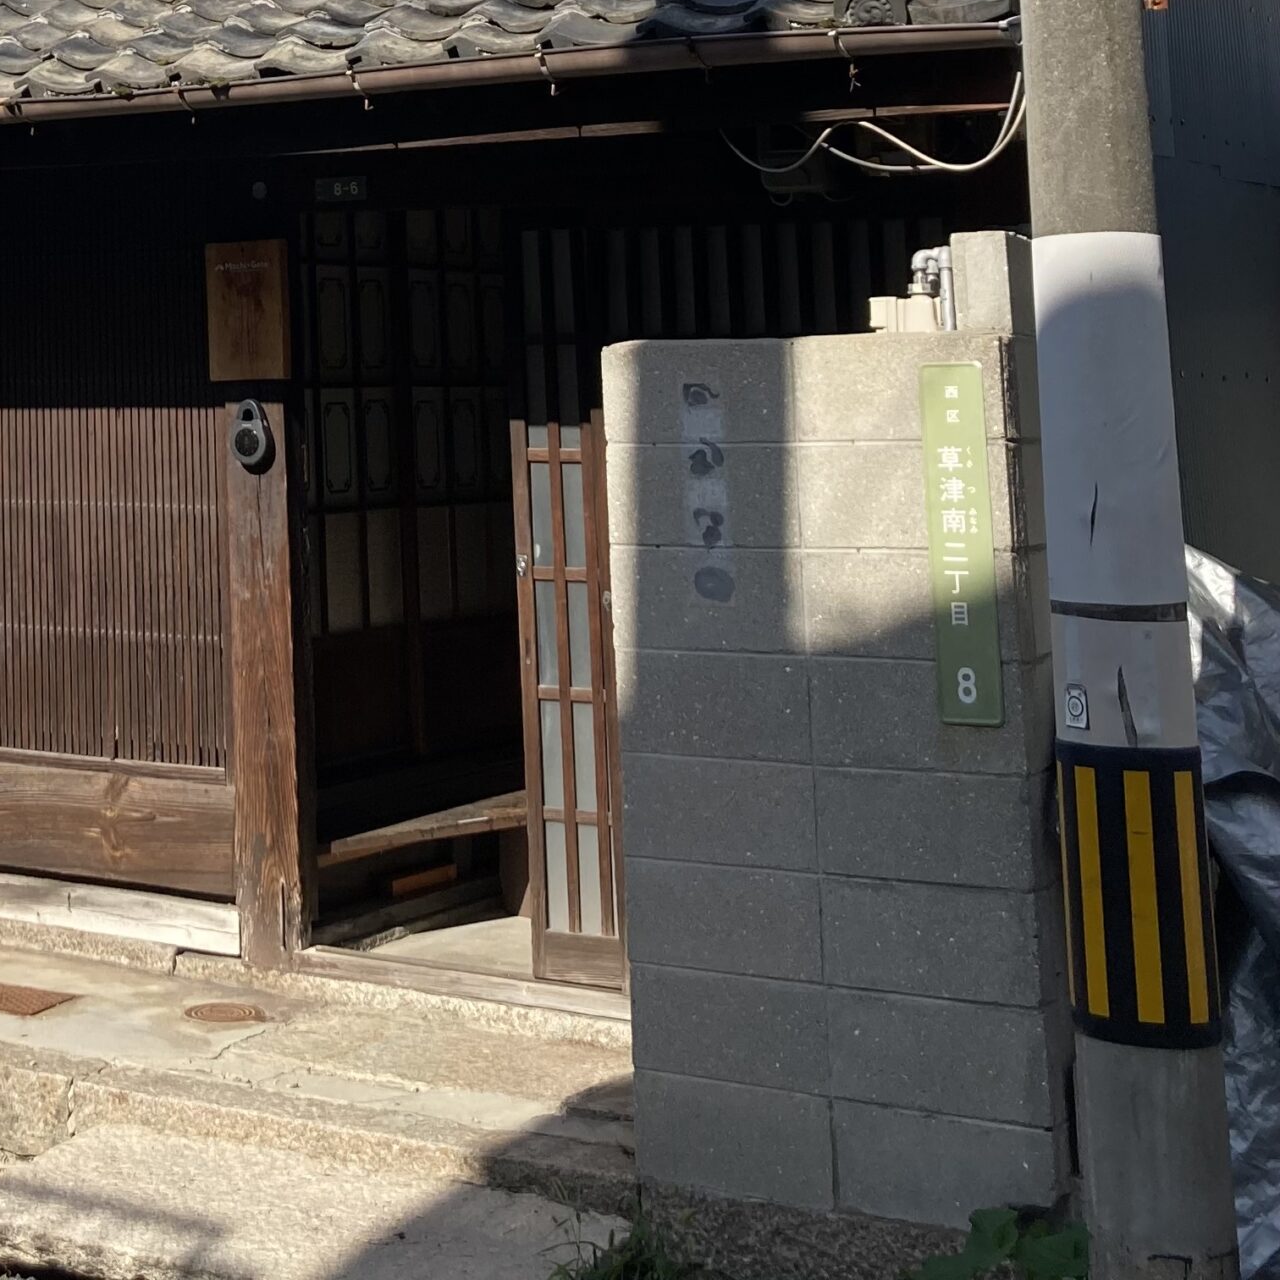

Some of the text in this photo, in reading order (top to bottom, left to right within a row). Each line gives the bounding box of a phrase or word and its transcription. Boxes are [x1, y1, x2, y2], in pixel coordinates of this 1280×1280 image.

[333, 181, 359, 196] 8-6
[944, 385, 961, 423] 西区
[937, 445, 969, 625] 草津南二丁目
[957, 667, 977, 704] 8
